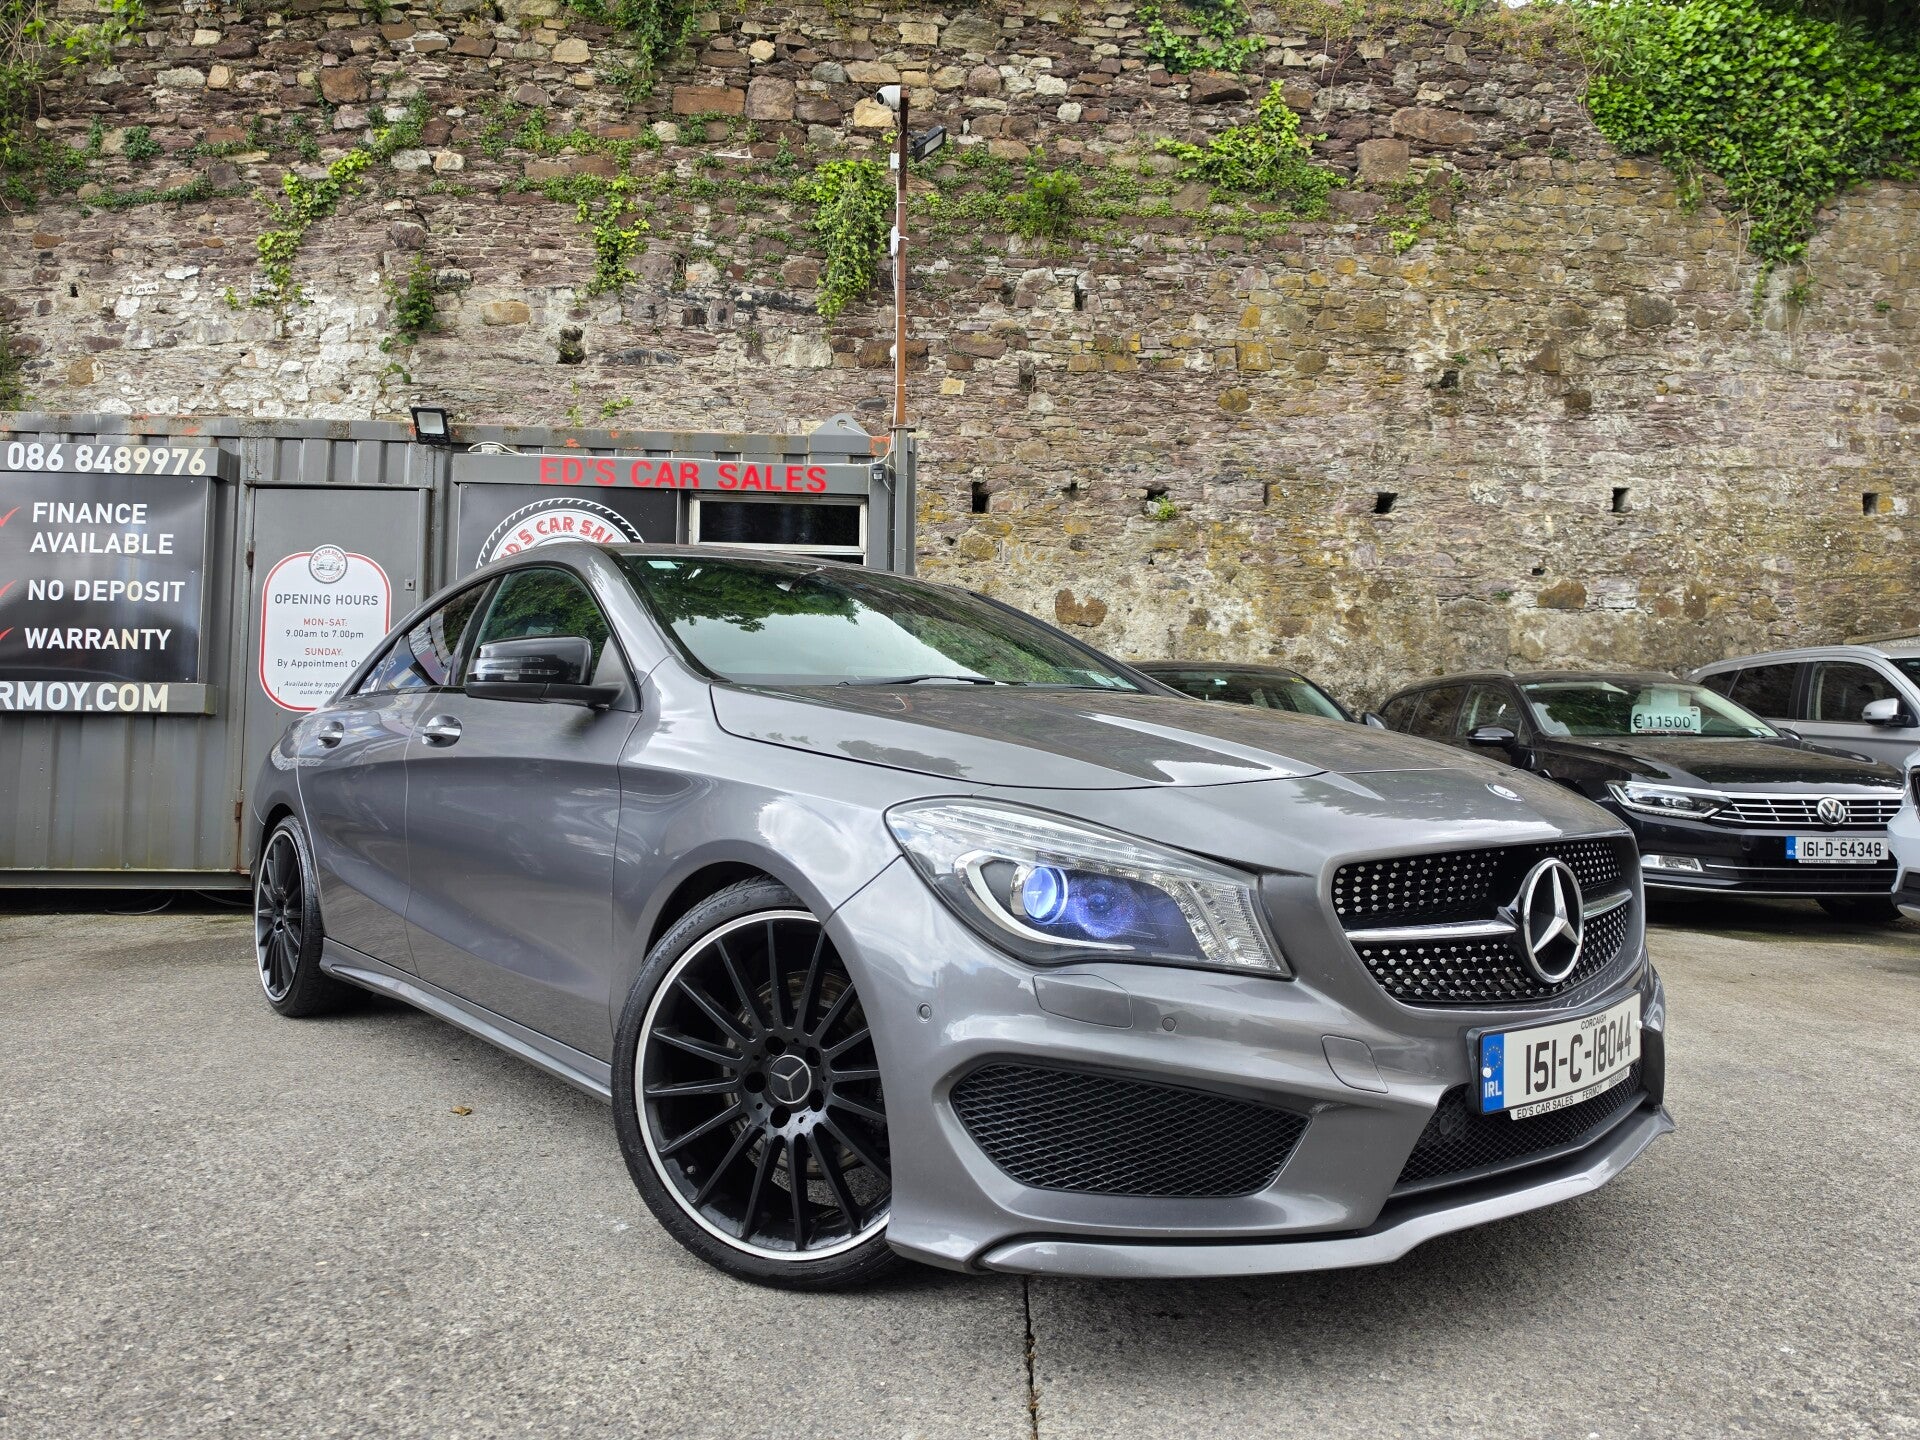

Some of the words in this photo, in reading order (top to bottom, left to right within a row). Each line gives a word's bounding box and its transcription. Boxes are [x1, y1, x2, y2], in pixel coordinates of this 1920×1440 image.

[7, 442, 64, 472] 086
[75, 444, 206, 476] 8489976
[540, 457, 617, 486] ED'S
[630, 461, 699, 488] CAR
[717, 464, 827, 492] SALES
[32, 502, 148, 525] FINANCE
[536, 516, 575, 535] CAR
[29, 532, 174, 555] AVAILABLE
[28, 579, 64, 601] NO
[74, 580, 186, 602] DEPOSIT
[275, 593, 331, 605] OPENING
[335, 594, 379, 606] HOURS
[24, 627, 172, 650] WARRANTY
[285, 629, 318, 638] 9.00am
[320, 630, 329, 638] to
[332, 630, 364, 640] 7.00pm
[277, 658, 289, 669] By
[290, 659, 348, 669] Appointment
[1803, 841, 1882, 857] 161-D-64348
[1580, 1013, 1607, 1030] CORCAIGH
[1525, 1011, 1632, 1095] 151-C-18044
[1484, 1080, 1502, 1098] IRL
[1516, 1106, 1534, 1119] ED'S
[1535, 1101, 1550, 1114] CAR
[1552, 1095, 1574, 1110] SALES
